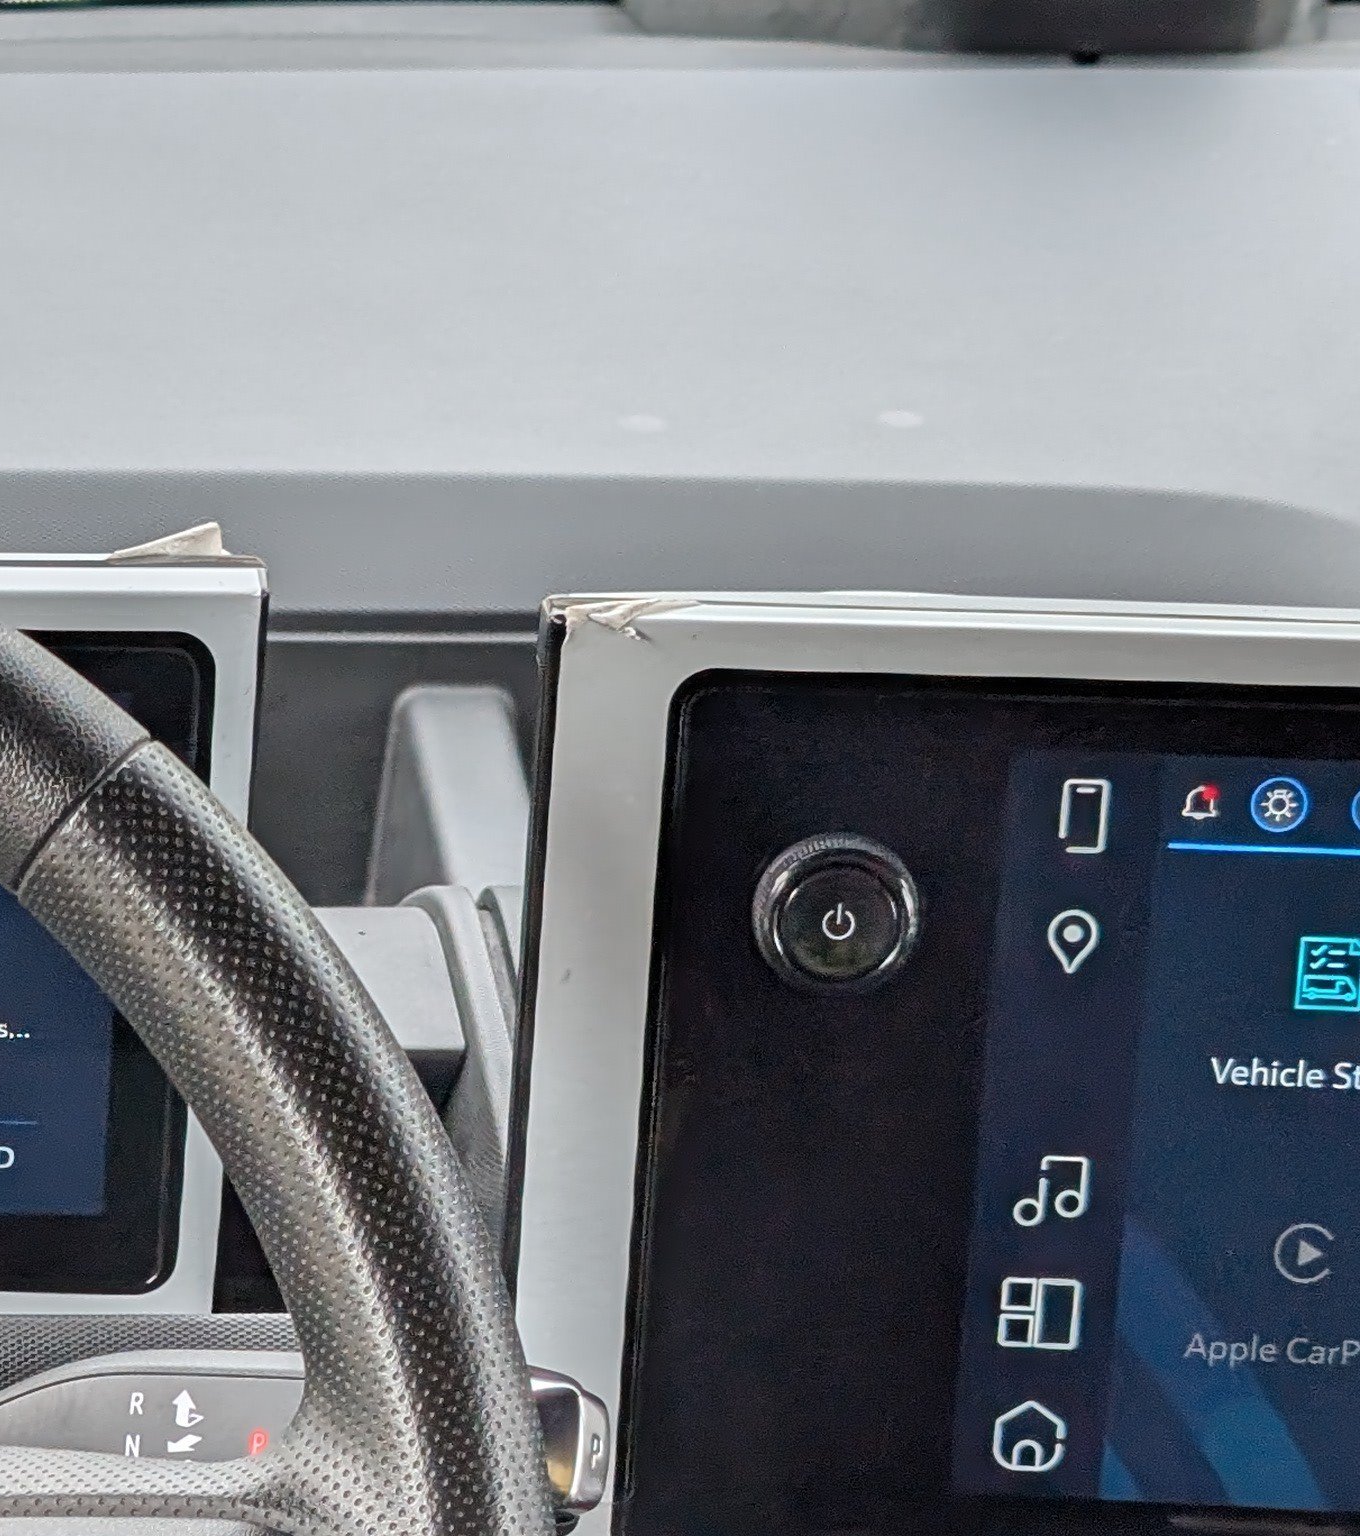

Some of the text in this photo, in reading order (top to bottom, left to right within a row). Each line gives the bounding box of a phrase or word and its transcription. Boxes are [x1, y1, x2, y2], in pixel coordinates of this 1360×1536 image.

[1210, 1056, 1326, 1089] Vehicle
[1183, 1332, 1360, 1368] Apple CarP
[129, 1391, 144, 1415] R
[124, 1434, 141, 1459] N
[250, 1432, 267, 1456] P
[590, 1432, 603, 1470] P
